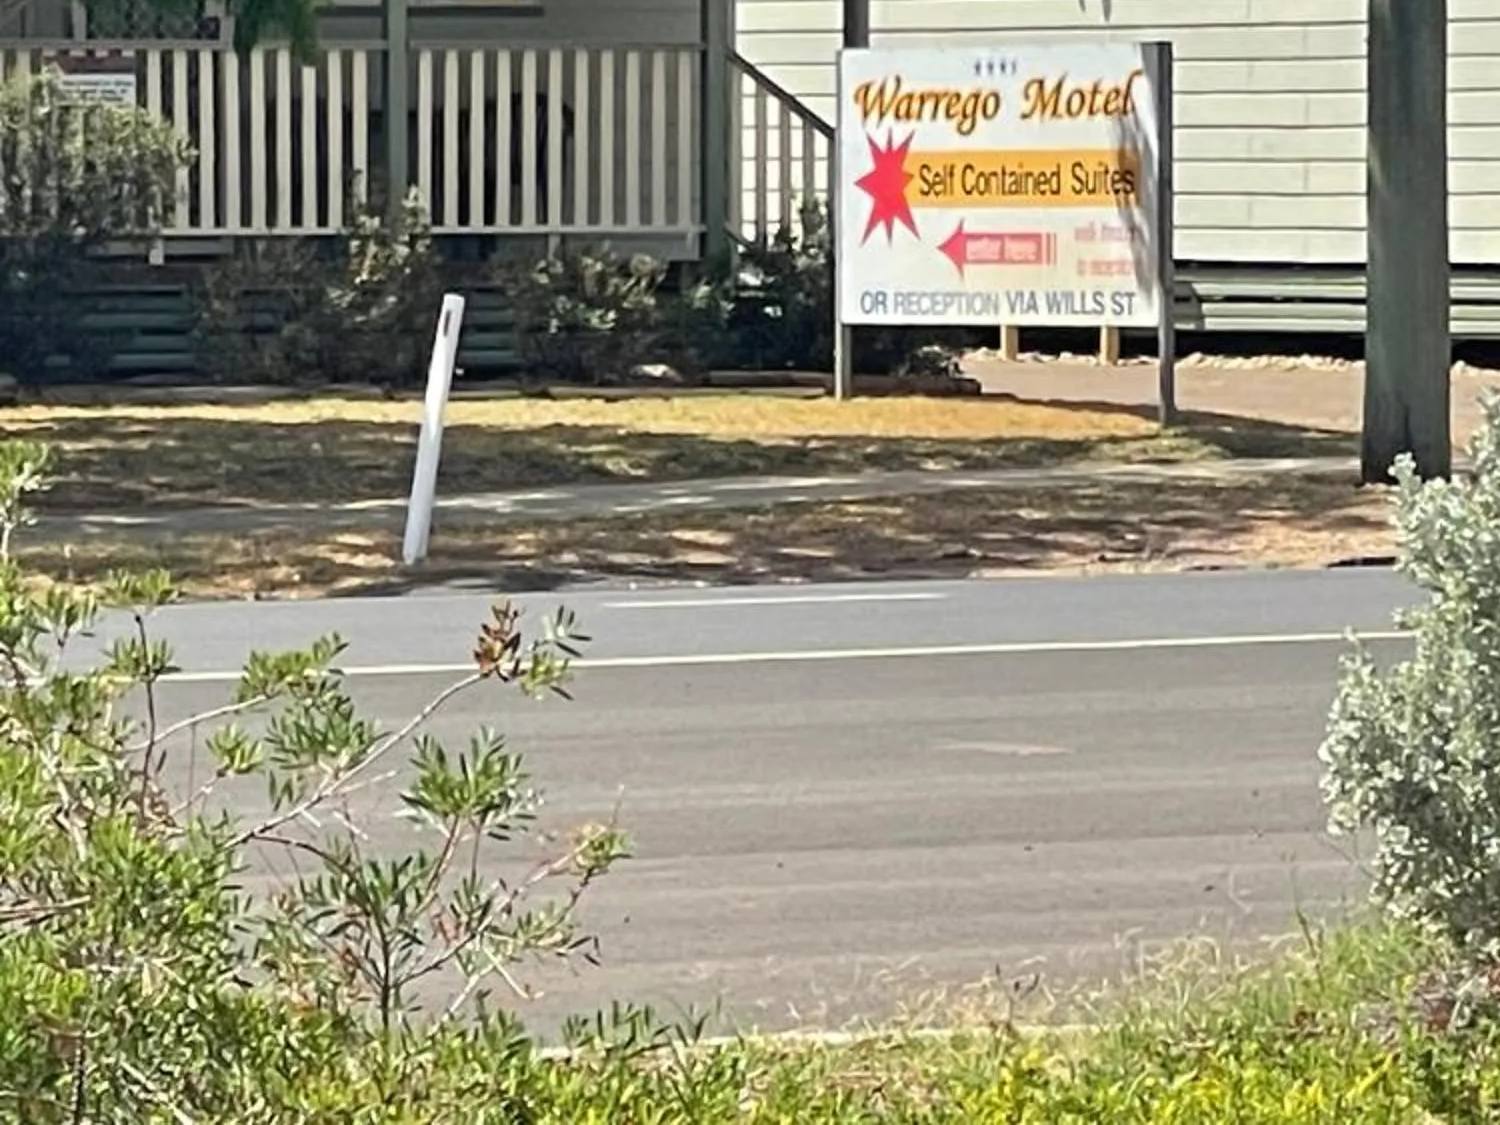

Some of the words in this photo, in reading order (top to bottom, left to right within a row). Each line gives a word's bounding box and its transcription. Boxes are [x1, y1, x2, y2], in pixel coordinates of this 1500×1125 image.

[854, 74, 1001, 136] Warrego
[1020, 70, 1143, 121] Motel
[918, 163, 955, 197] Self
[961, 162, 1061, 196] Contained
[1071, 161, 1136, 196] Suites
[860, 291, 888, 316] OR
[893, 292, 998, 316] RECEPTION
[1005, 291, 1039, 315] VIA
[1045, 291, 1105, 316] WILLS
[1111, 292, 1137, 316] ST
